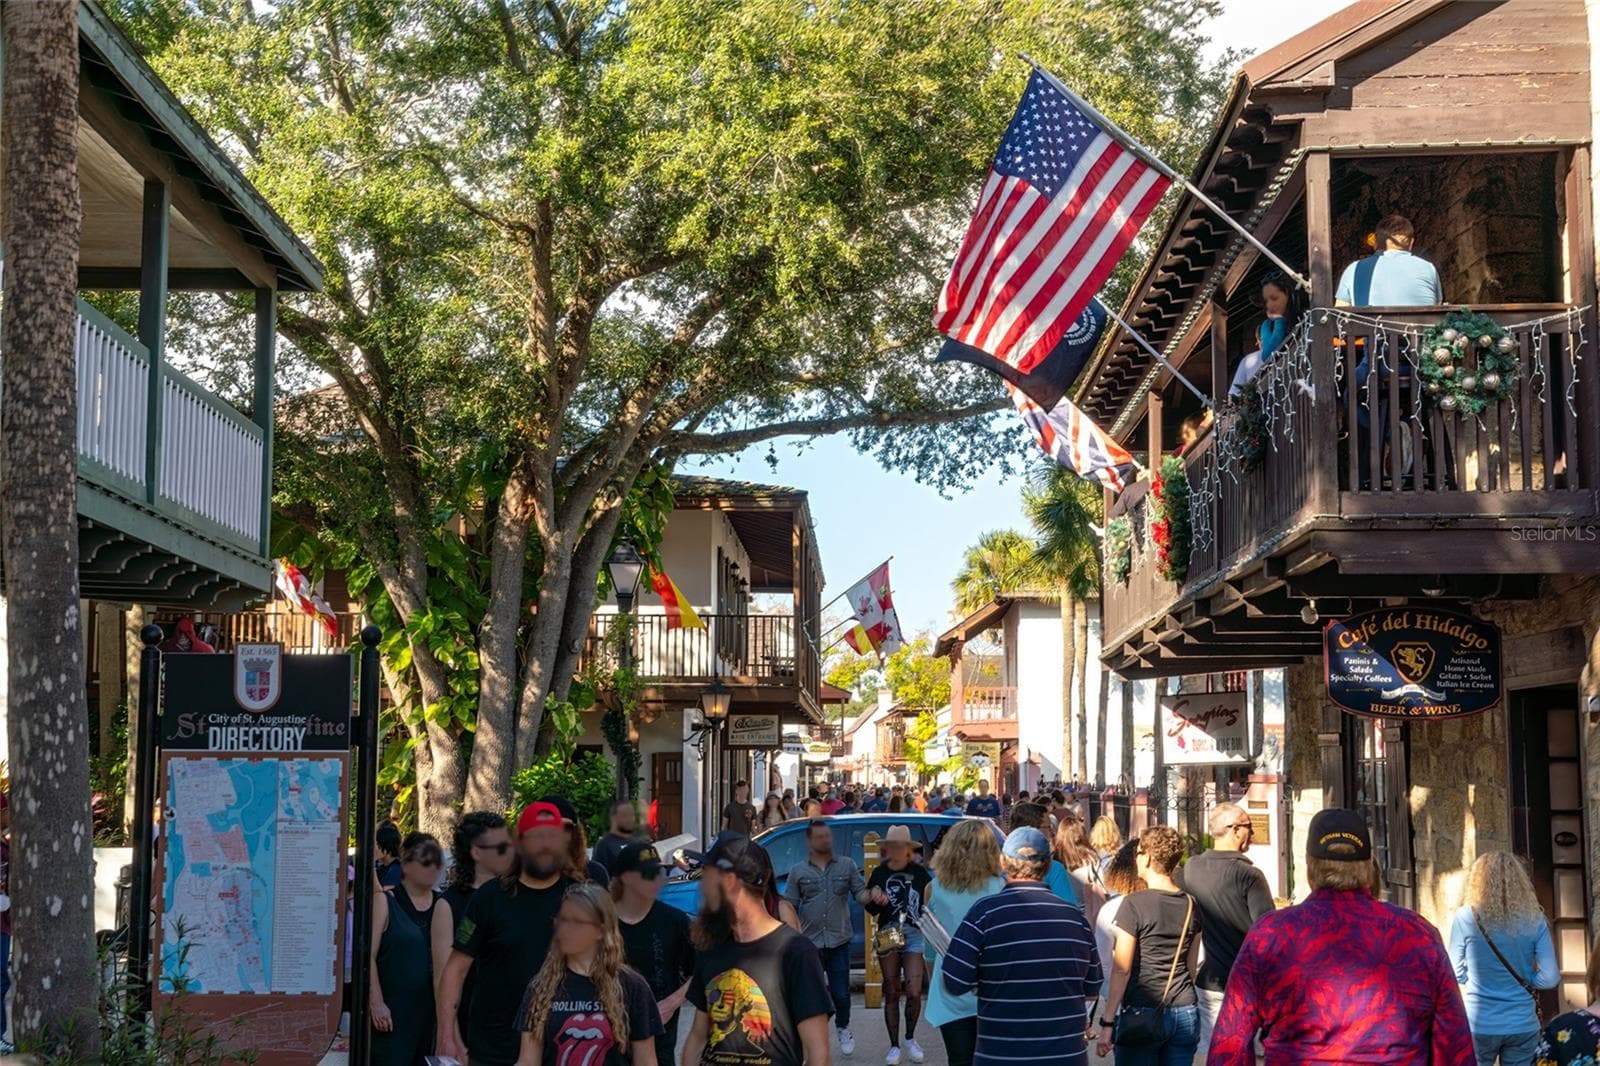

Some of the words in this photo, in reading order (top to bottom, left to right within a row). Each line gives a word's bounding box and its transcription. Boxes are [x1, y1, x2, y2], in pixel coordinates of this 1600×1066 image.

[1338, 614, 1378, 648] Café
[1382, 611, 1410, 632] del
[1416, 613, 1488, 649] Hidalgo
[1344, 657, 1370, 665] Paninis
[1331, 674, 1363, 683] Specialty
[1364, 674, 1392, 683] Coffees
[1370, 703, 1407, 715] BEER
[1409, 706, 1421, 715] &
[1424, 703, 1462, 715] WINE
[208, 714, 229, 726] City
[231, 713, 241, 723] of
[243, 714, 255, 723] St.
[258, 714, 306, 726] Augustine
[208, 727, 307, 751] DIRECTORY
[552, 1001, 592, 1012] ROLLING
